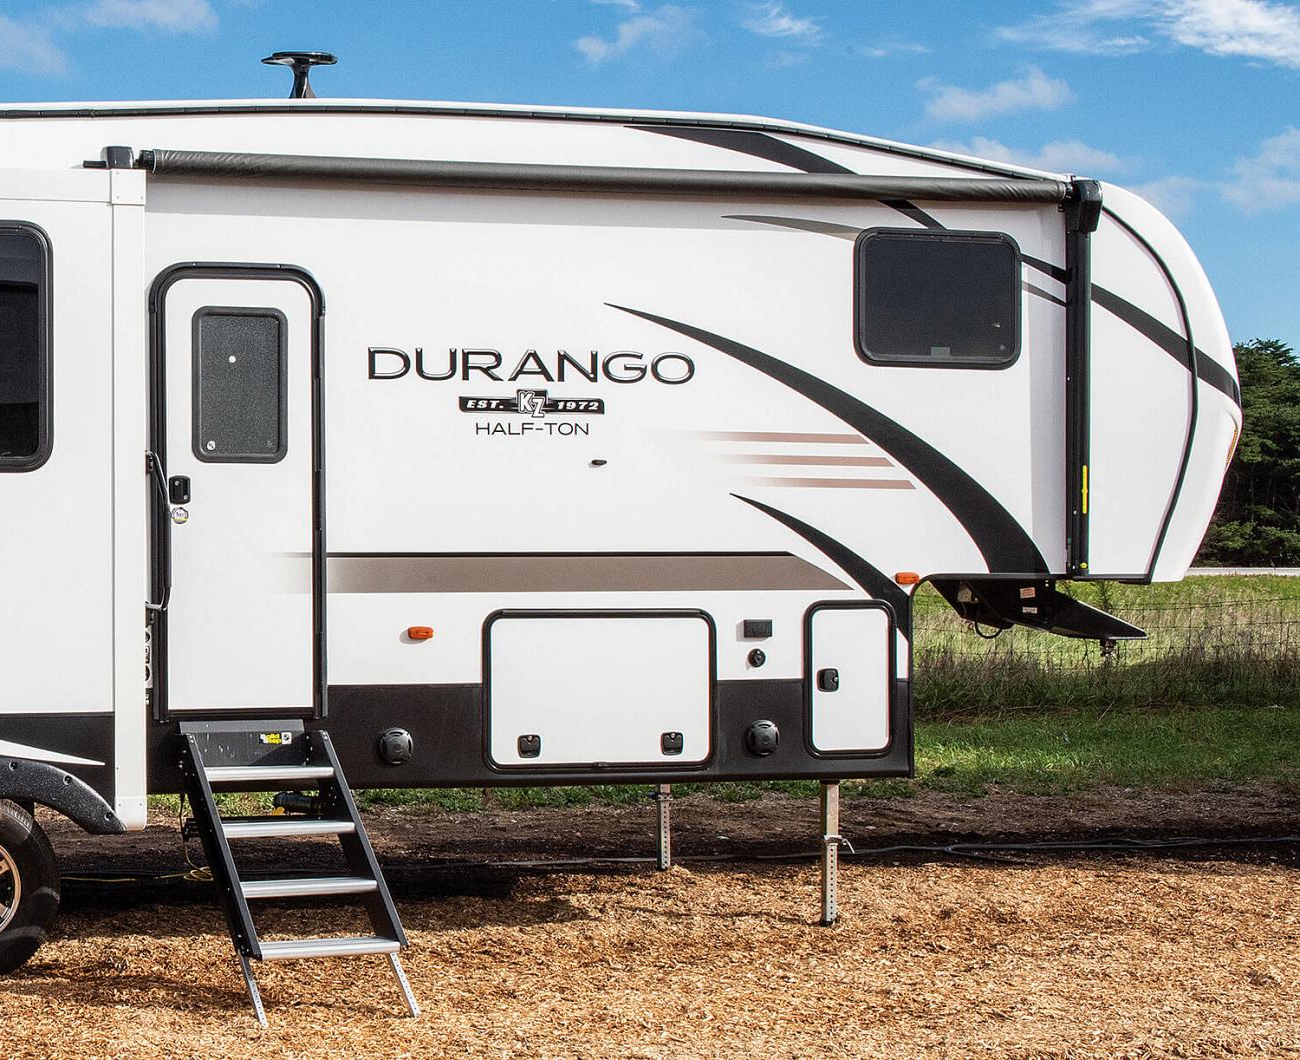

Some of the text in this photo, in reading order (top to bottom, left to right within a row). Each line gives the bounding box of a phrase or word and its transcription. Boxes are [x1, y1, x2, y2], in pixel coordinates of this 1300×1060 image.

[368, 346, 695, 384] DURANGO
[466, 390, 600, 418] EST. KZ 1972
[475, 422, 590, 436] HALF-TON
